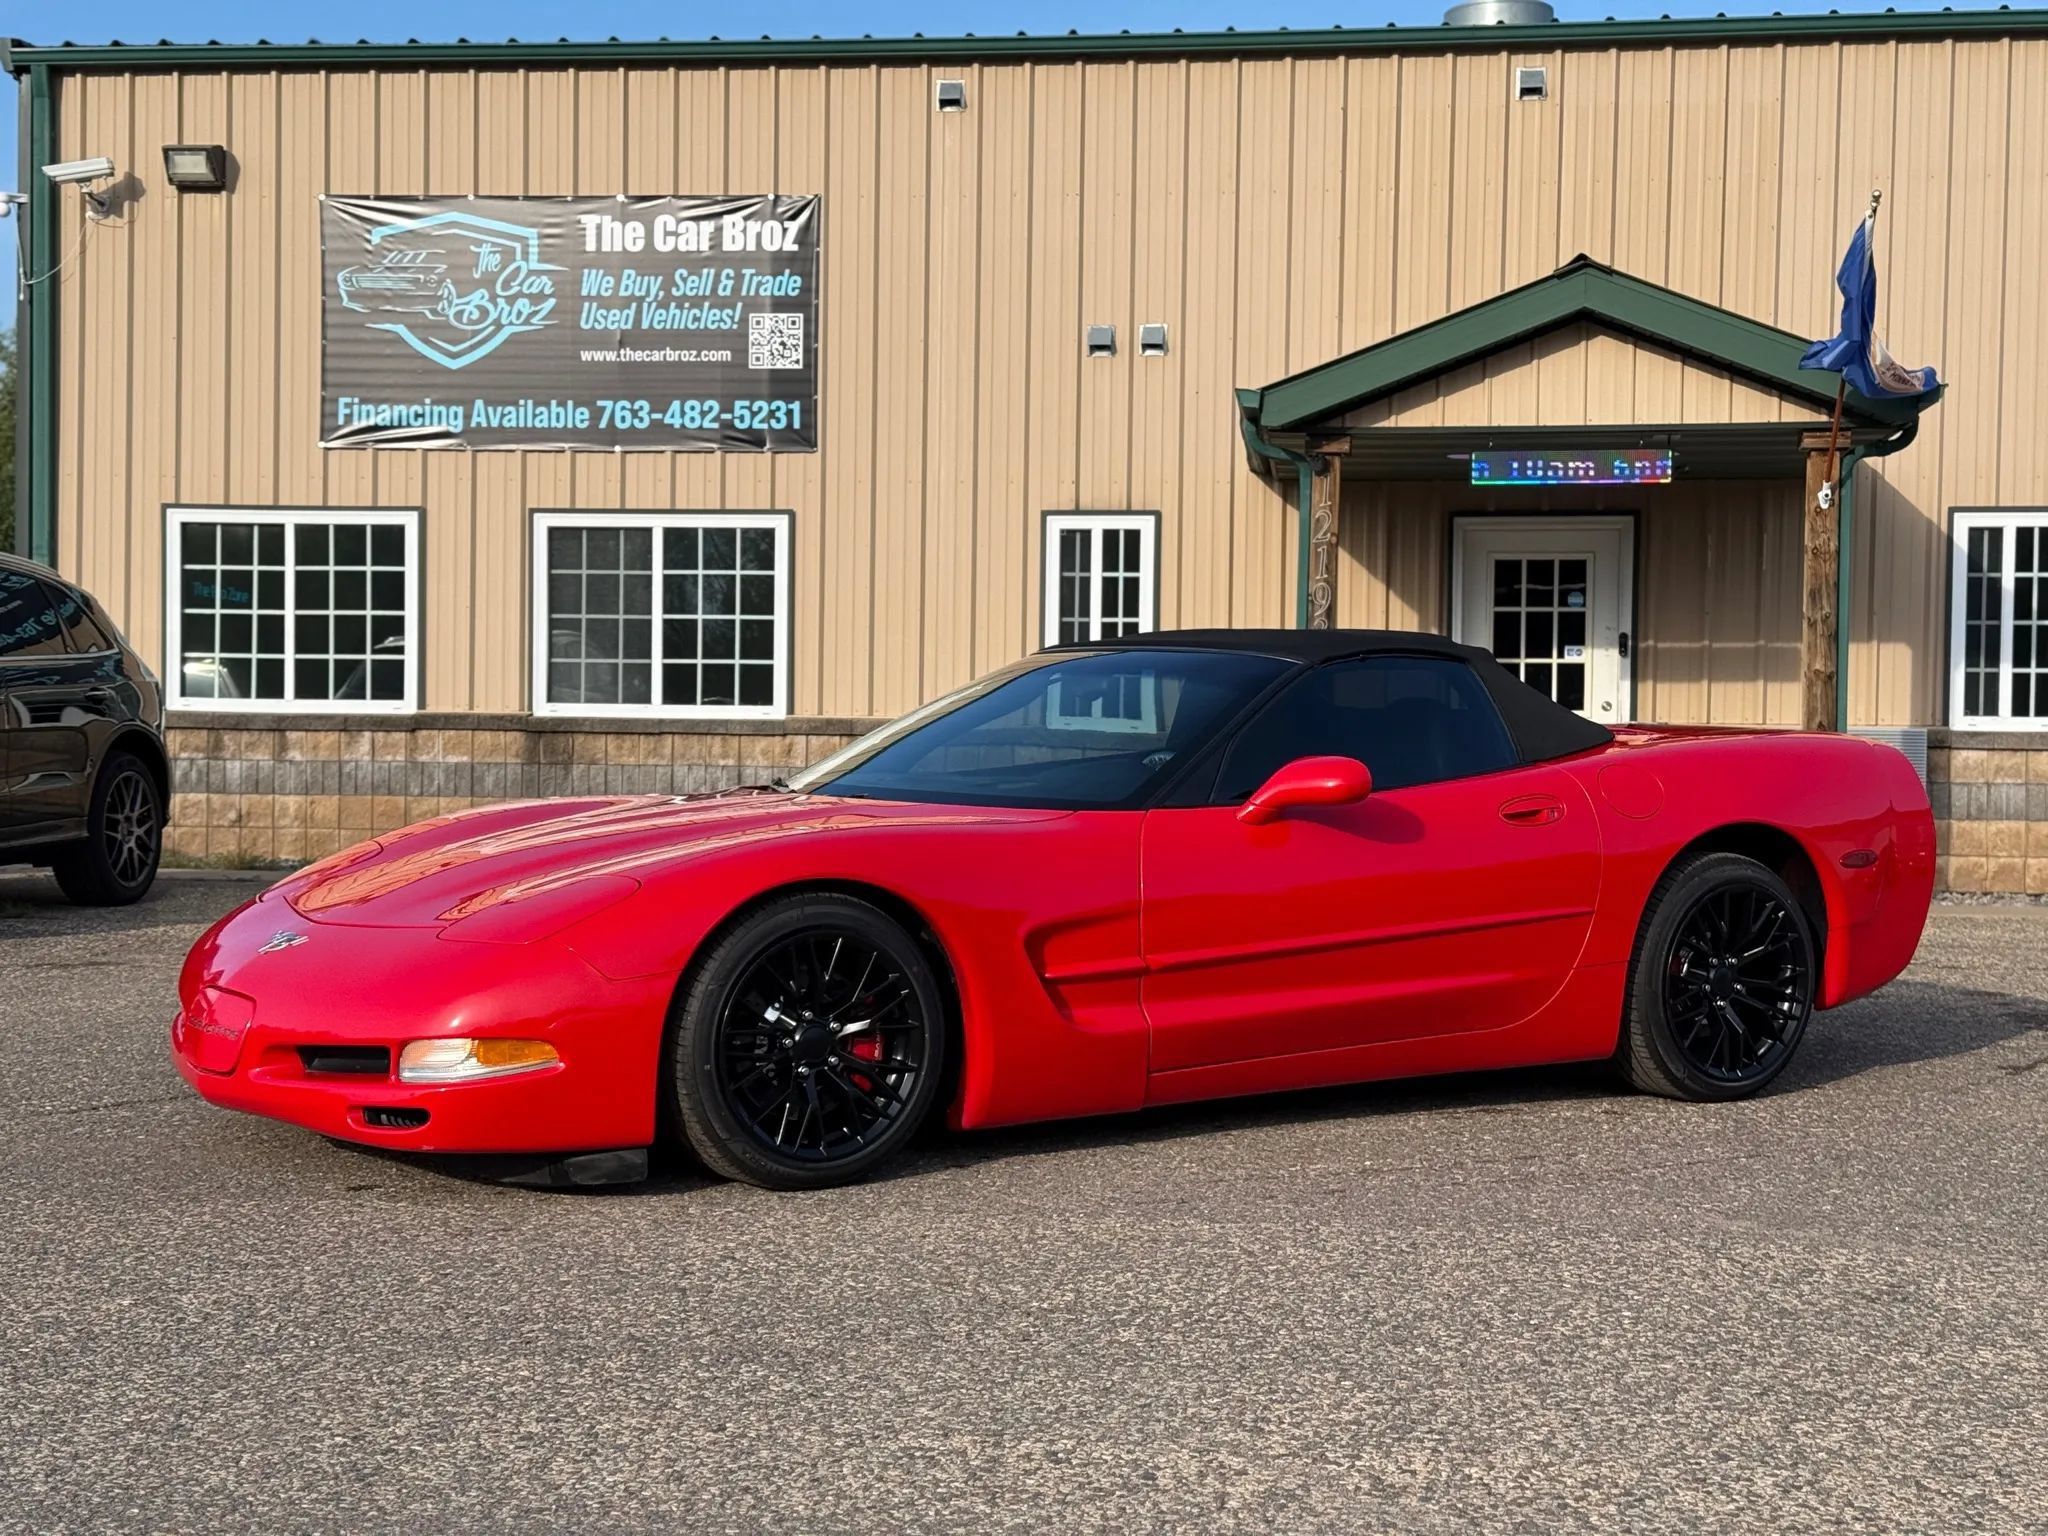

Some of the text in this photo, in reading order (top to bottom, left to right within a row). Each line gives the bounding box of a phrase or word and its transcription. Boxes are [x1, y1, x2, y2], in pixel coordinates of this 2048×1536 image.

[579, 214, 799, 252] The Car Broz
[495, 260, 555, 296] Car
[580, 268, 802, 302] We Buy, Sell & Trade
[449, 288, 559, 330] Broz
[580, 302, 743, 330] Used Vehicles!
[580, 347, 731, 362] www.thecarbroz.com
[337, 397, 800, 433] Financing Available 763-482-5231
